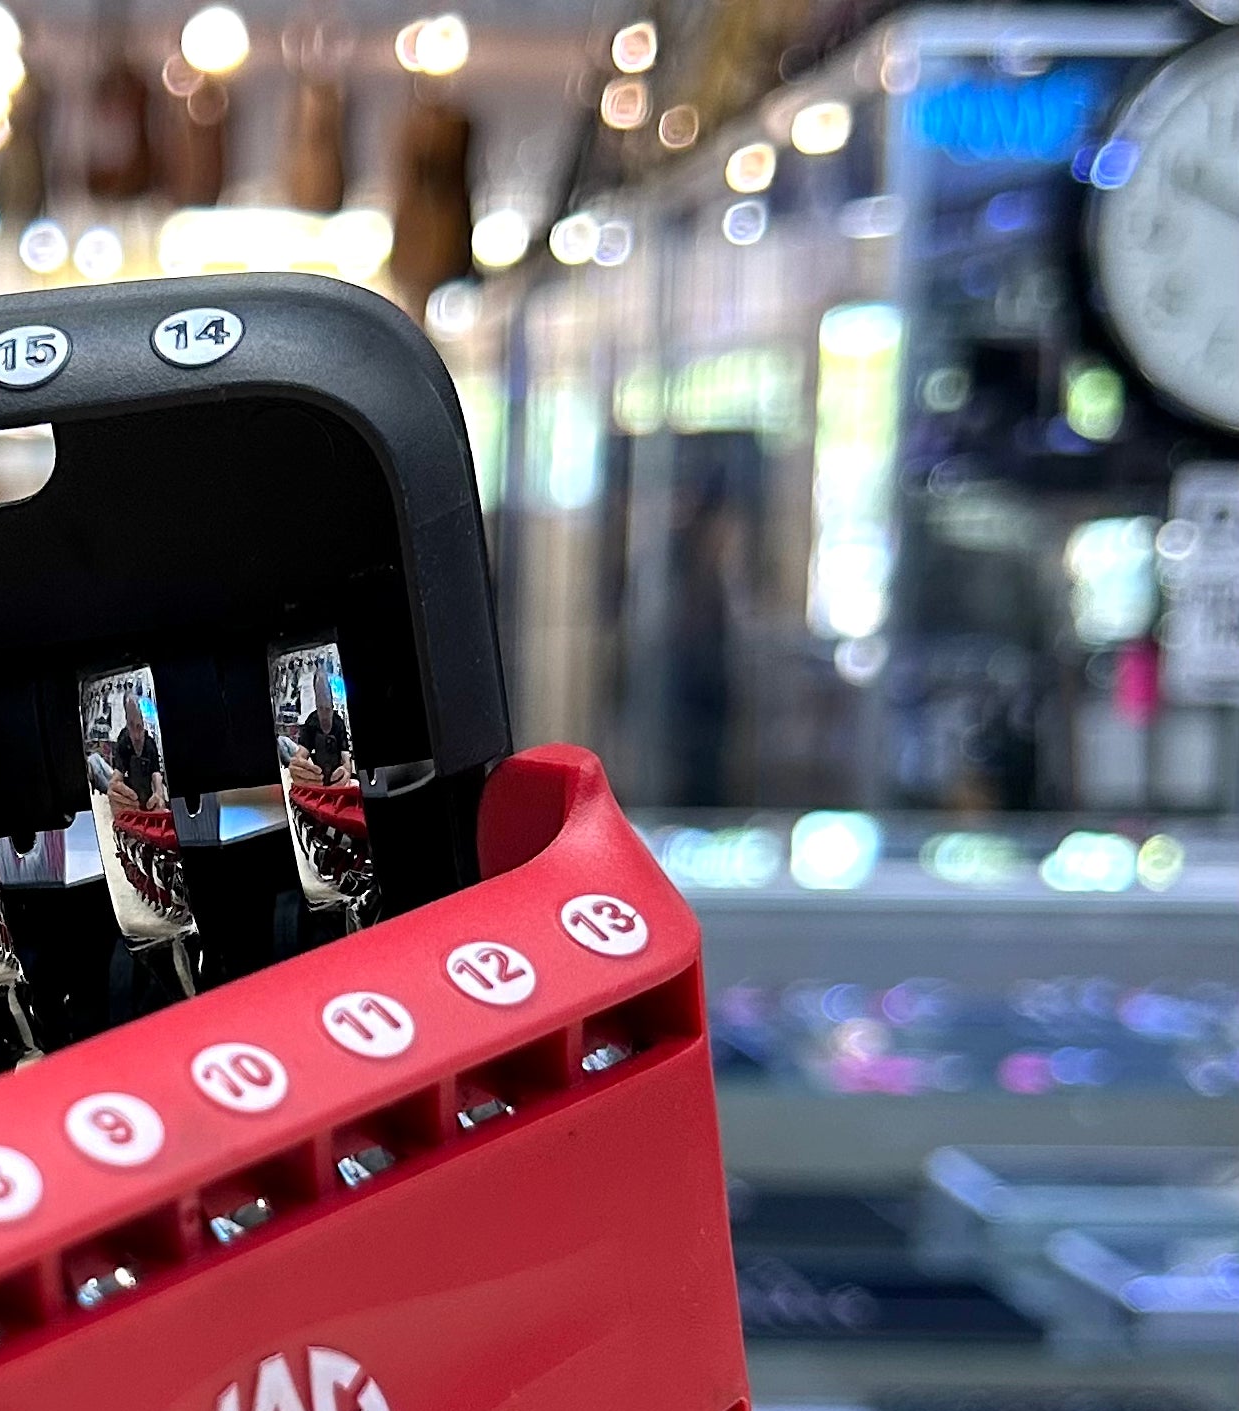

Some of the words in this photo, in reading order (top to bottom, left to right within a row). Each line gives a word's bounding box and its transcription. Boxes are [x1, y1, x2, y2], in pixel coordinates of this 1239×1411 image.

[164, 315, 231, 350] 14
[90, 1106, 135, 1144] 9
[201, 1051, 273, 1099] 10
[332, 997, 402, 1041] 11
[452, 946, 527, 990] 12
[568, 899, 635, 942] 13
